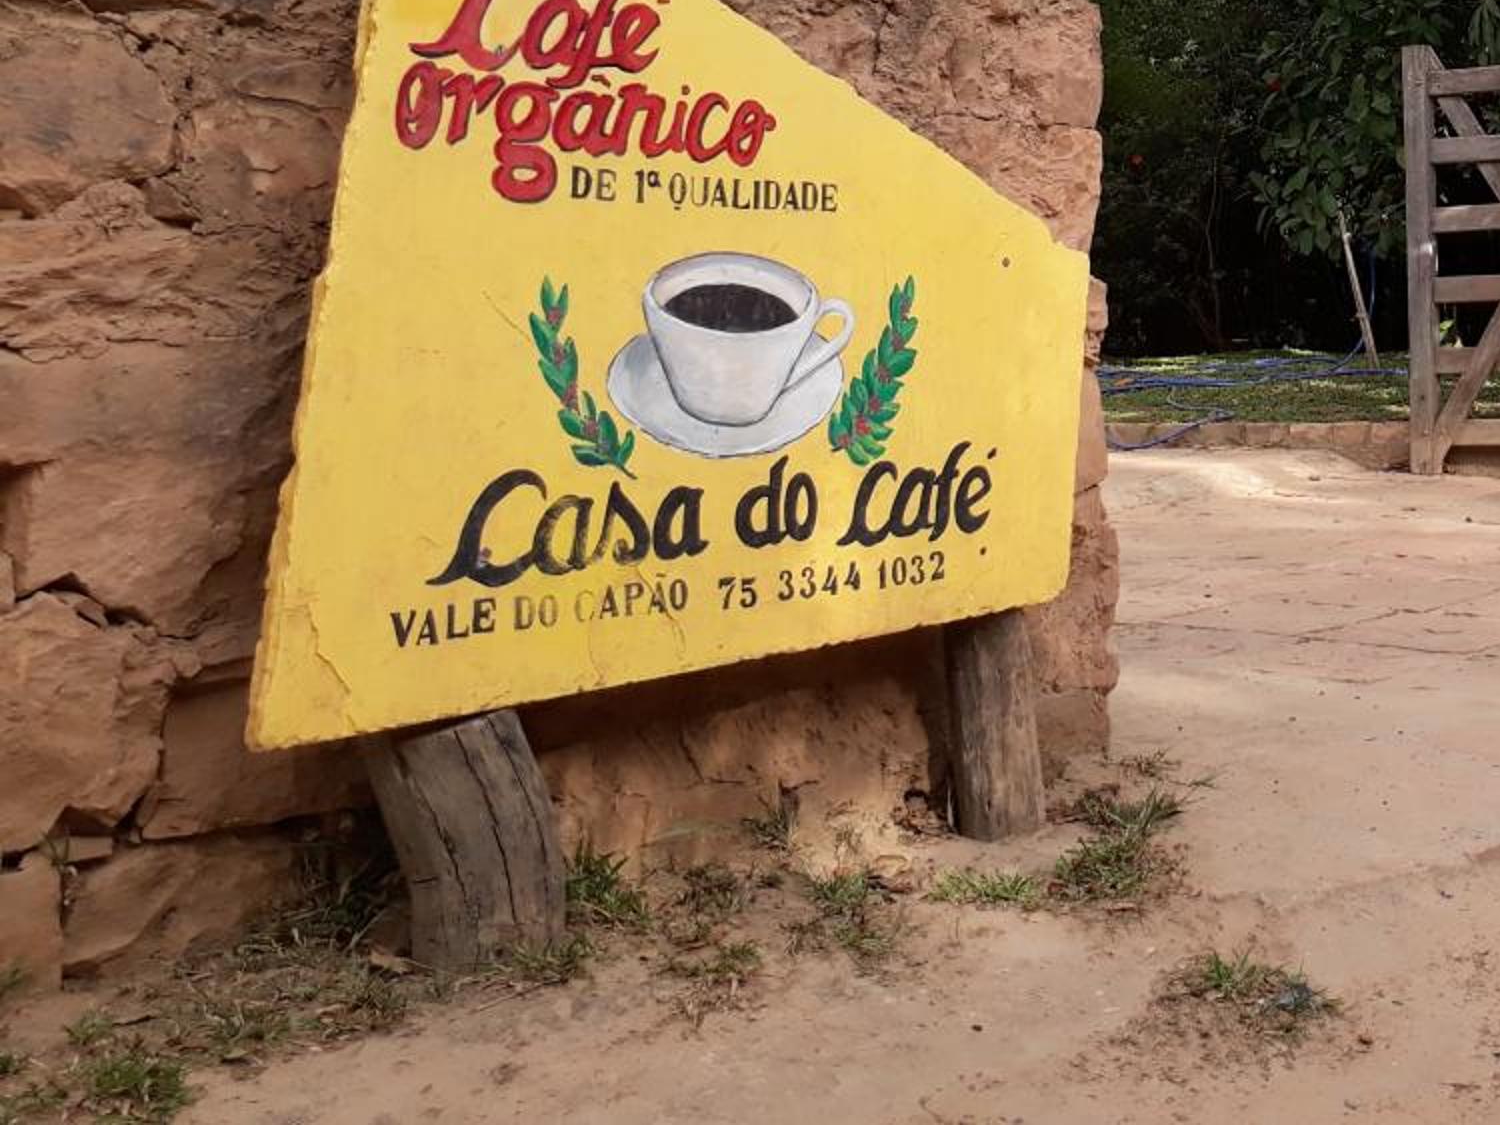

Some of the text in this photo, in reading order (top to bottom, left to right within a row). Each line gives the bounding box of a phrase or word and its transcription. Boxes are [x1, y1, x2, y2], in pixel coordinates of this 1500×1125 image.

[570, 166, 617, 201] DE
[669, 173, 838, 213] QUALIDADE
[425, 468, 710, 587] Casa
[734, 455, 819, 548] do
[389, 551, 946, 648] VALE DO CAPÃO 75 3344 1032
